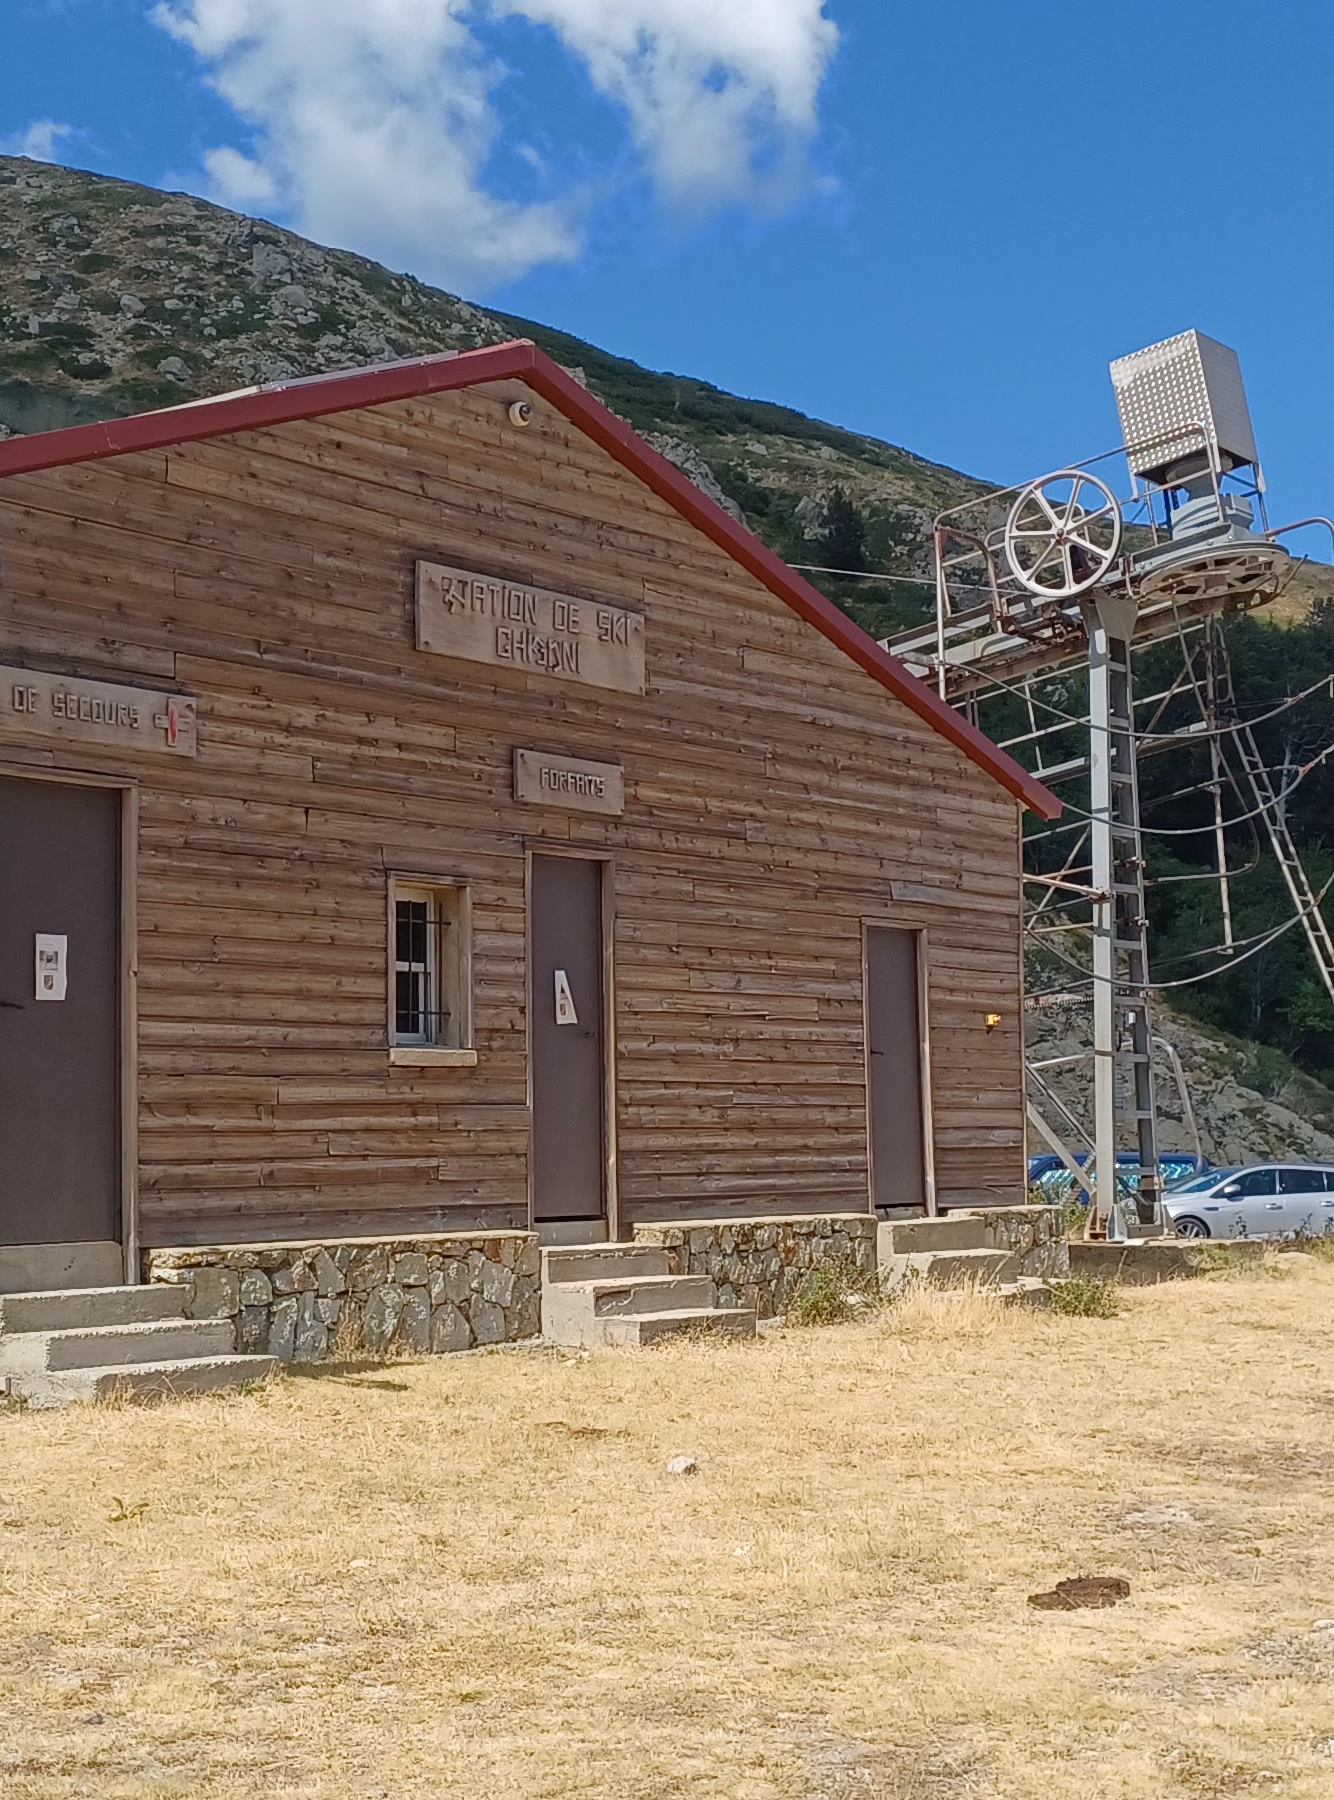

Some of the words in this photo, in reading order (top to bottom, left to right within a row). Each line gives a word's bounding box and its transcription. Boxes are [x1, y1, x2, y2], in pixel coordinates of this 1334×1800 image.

[553, 600, 581, 634] DE
[597, 611, 631, 647] SKI
[13, 685, 39, 713] DE
[53, 692, 139, 730] SECOURS
[540, 767, 605, 798] FORFAITS
